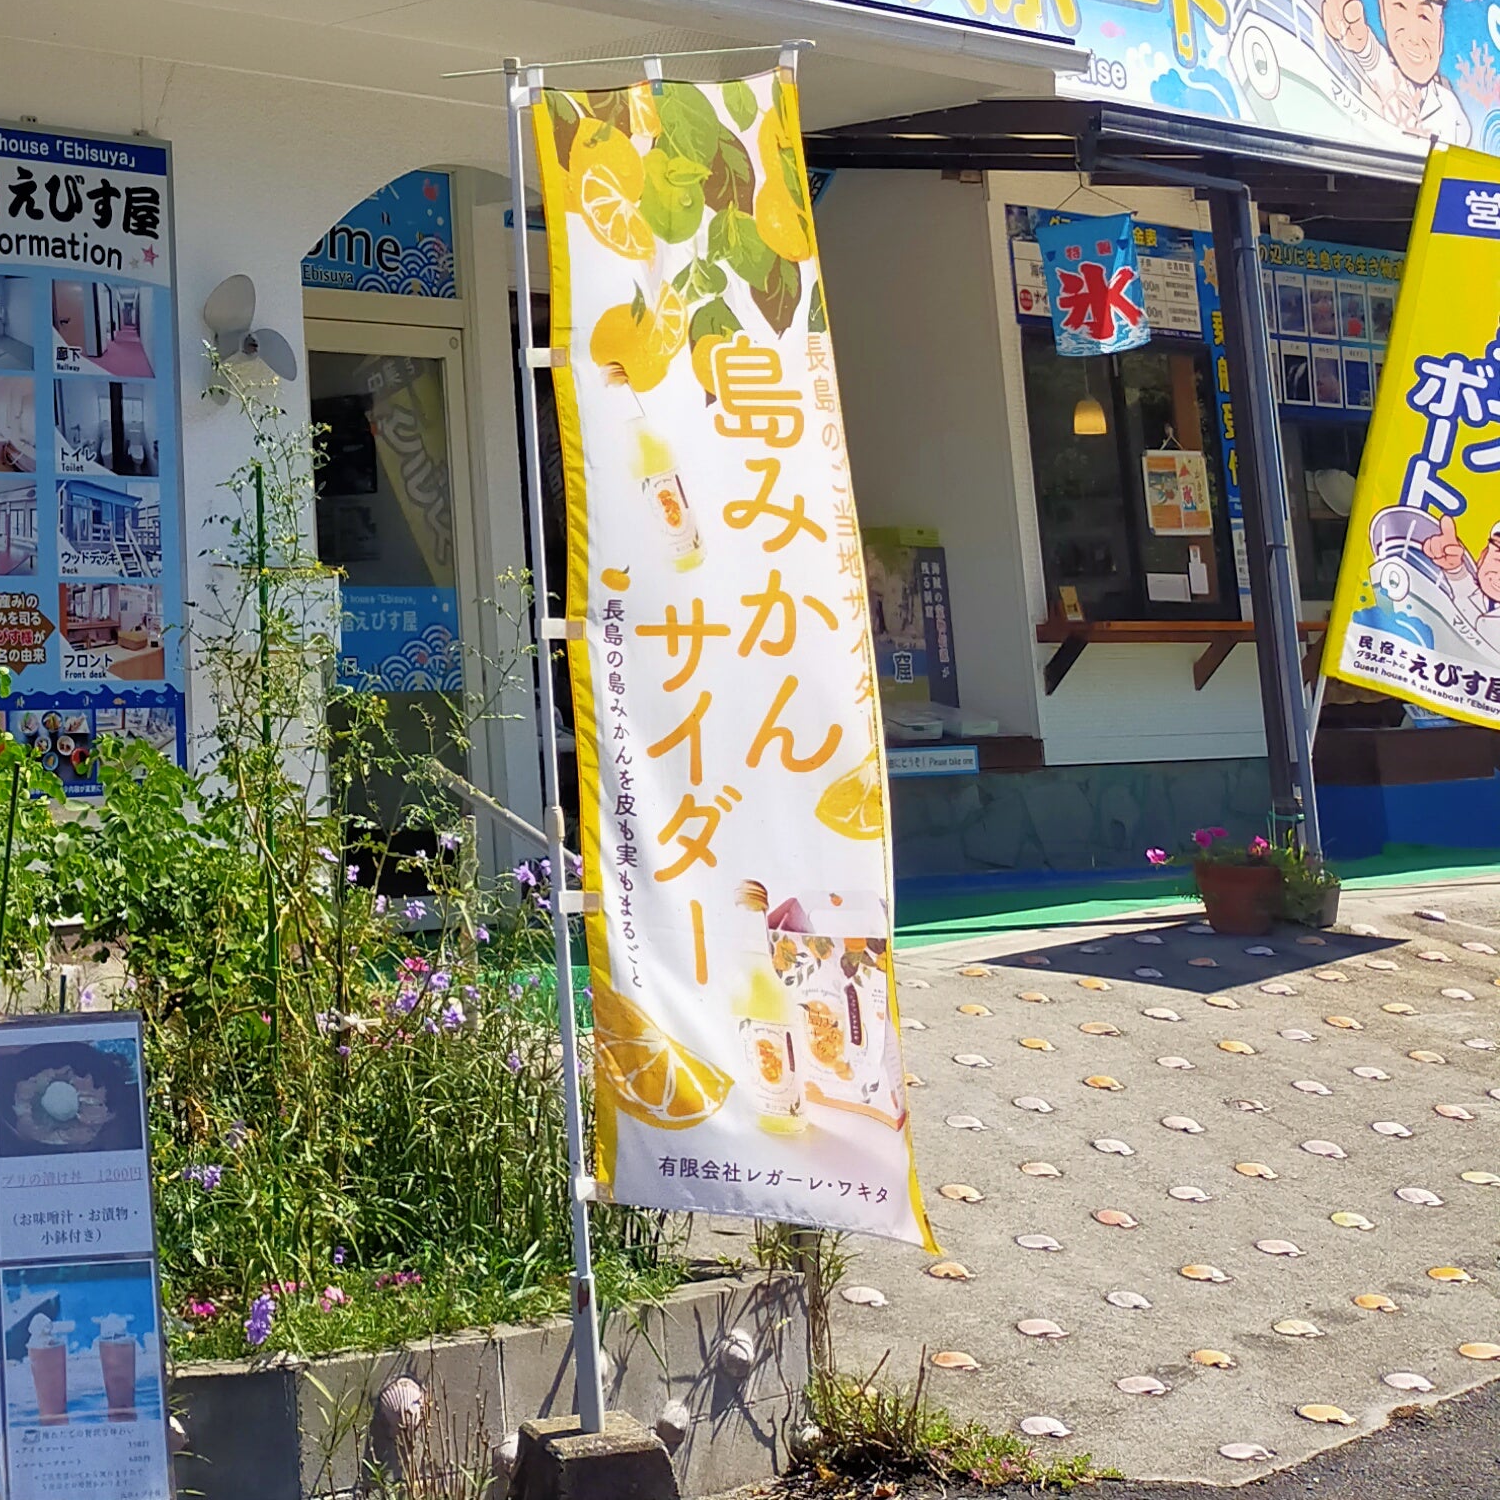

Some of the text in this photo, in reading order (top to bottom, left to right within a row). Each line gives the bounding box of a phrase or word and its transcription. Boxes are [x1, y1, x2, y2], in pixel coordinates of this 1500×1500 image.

[302, 264, 355, 285] Ebisuya
[1057, 262, 1145, 341] 氷
[56, 347, 81, 361] 廊下
[1407, 358, 1494, 510] ボート
[61, 447, 96, 461] トイレ
[62, 463, 84, 472] Toilet
[61, 551, 118, 565] ウッドデッキ
[713, 335, 843, 773] 島みかん
[62, 566, 78, 574] Deck
[64, 653, 113, 668] フロント
[65, 670, 107, 679] Front desk
[1353, 661, 1378, 674] Guest
[1381, 668, 1408, 682] house
[602, 599, 643, 988] 長島の島みかんを皮も実もまるごと
[635, 597, 743, 985] サイダー
[658, 1156, 890, 1203] 有限会社レガーレ・ワキタ
